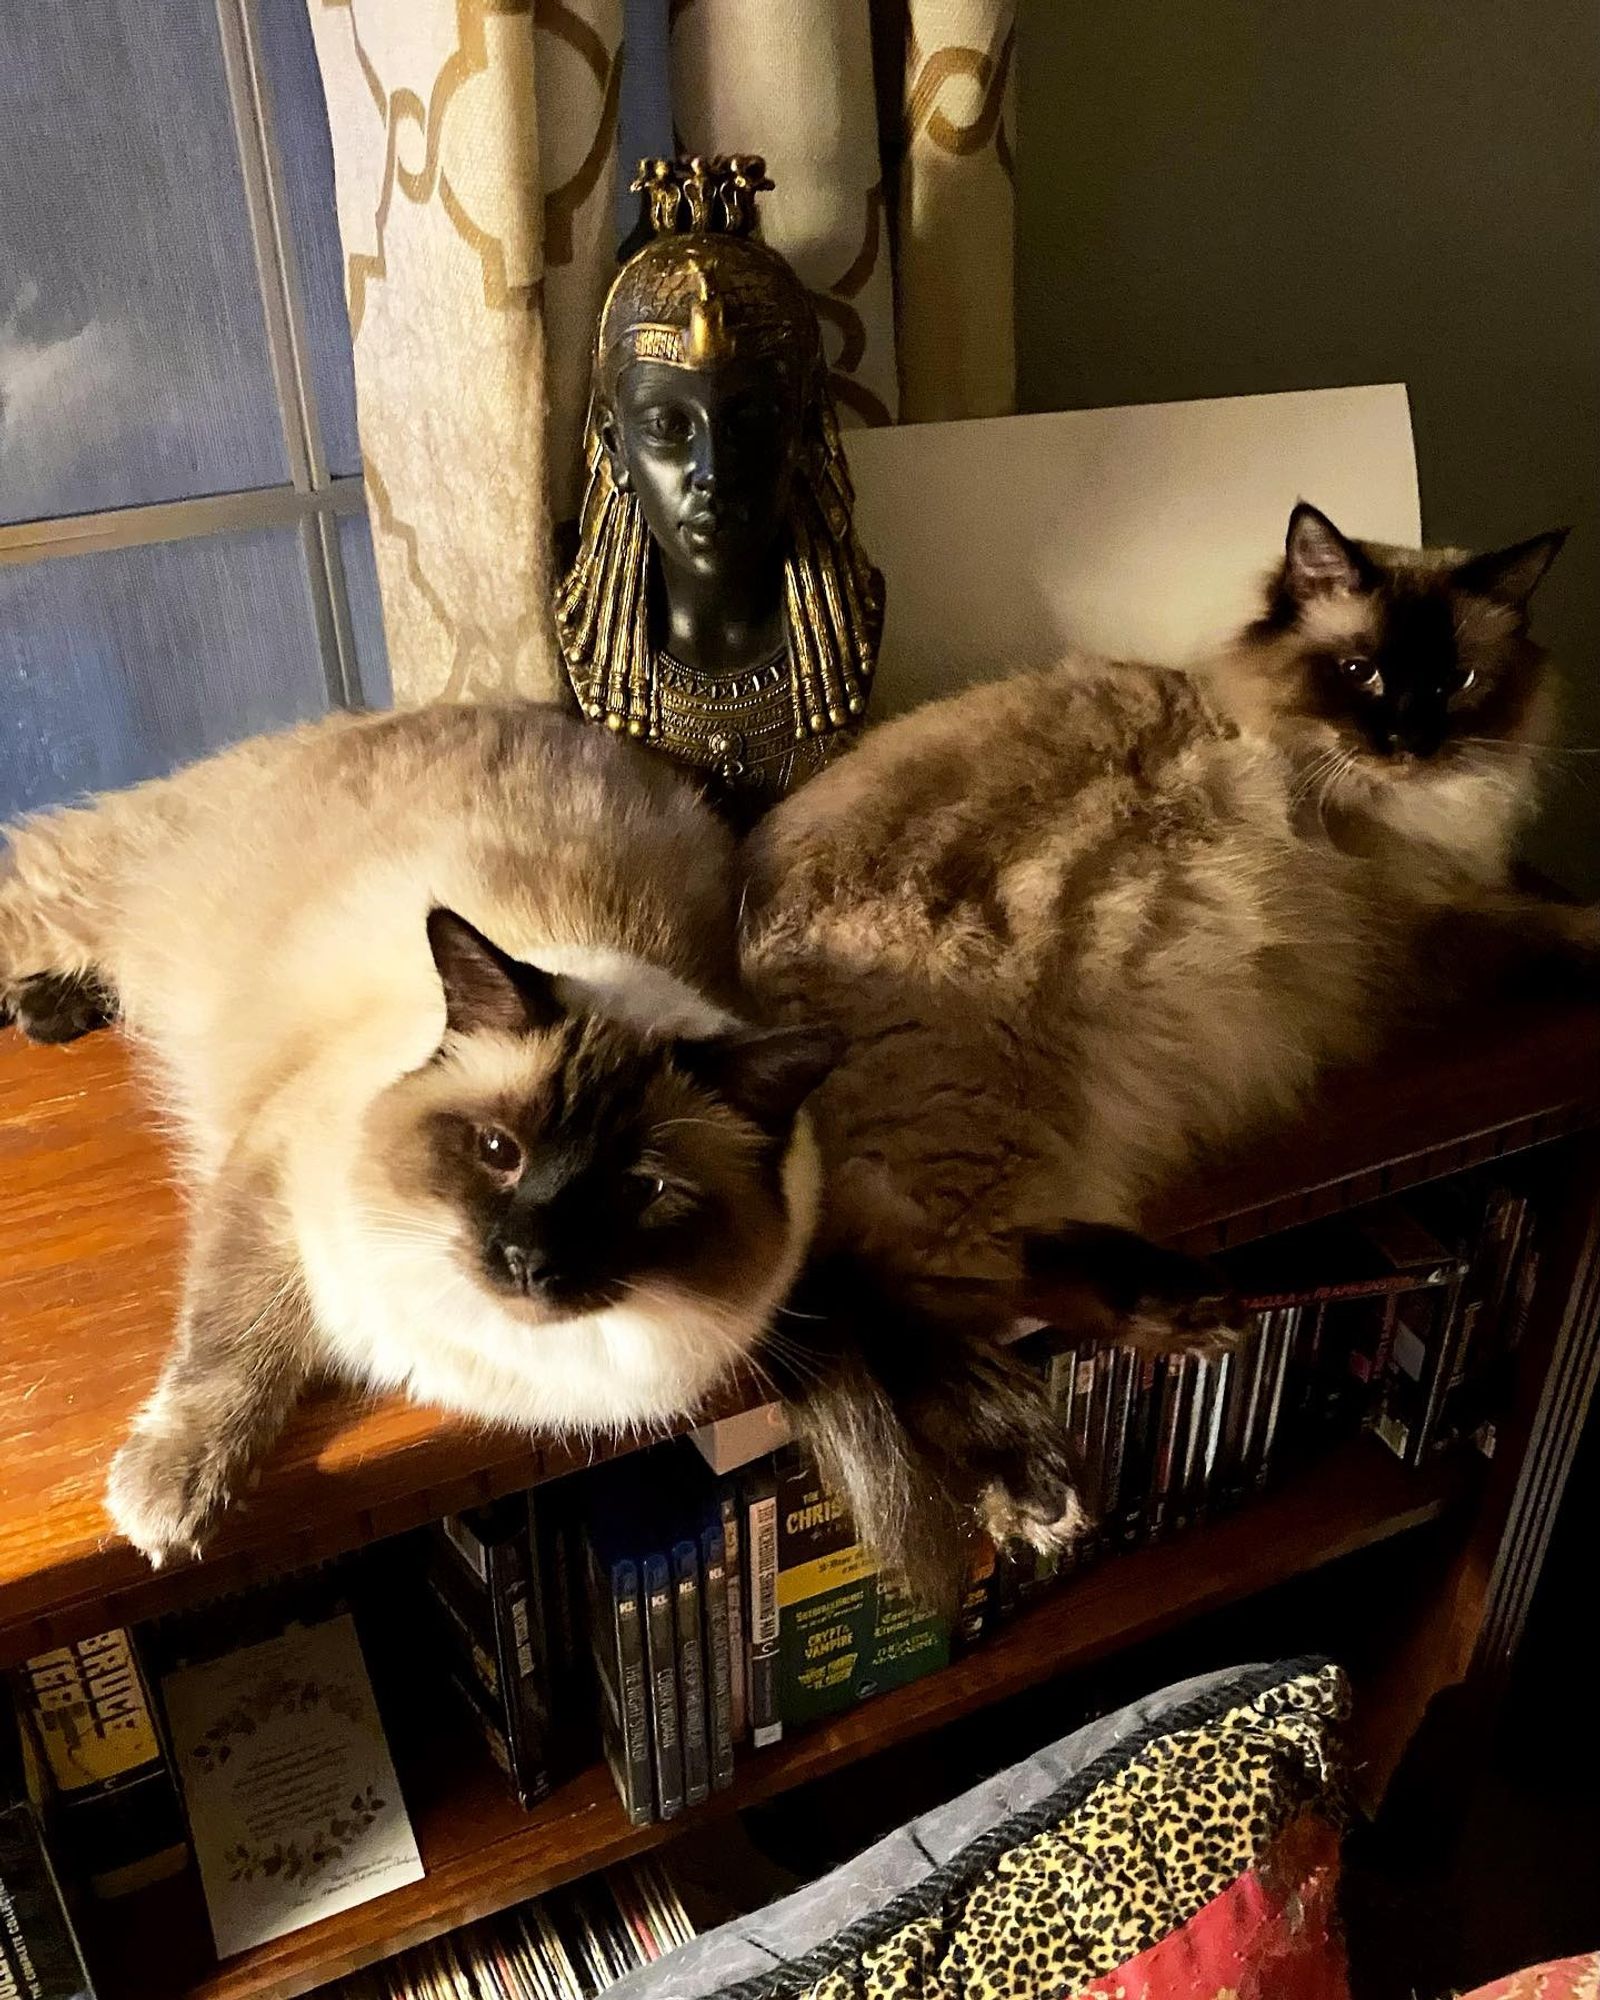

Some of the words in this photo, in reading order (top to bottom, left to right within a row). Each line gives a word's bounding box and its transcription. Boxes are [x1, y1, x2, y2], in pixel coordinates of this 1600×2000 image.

[785, 1499, 842, 1534] CHRIS
[804, 1632, 854, 1659] VAMPIRE
[807, 1623, 843, 1647] CRYPT
[660, 1708, 678, 1749] WOMAN
